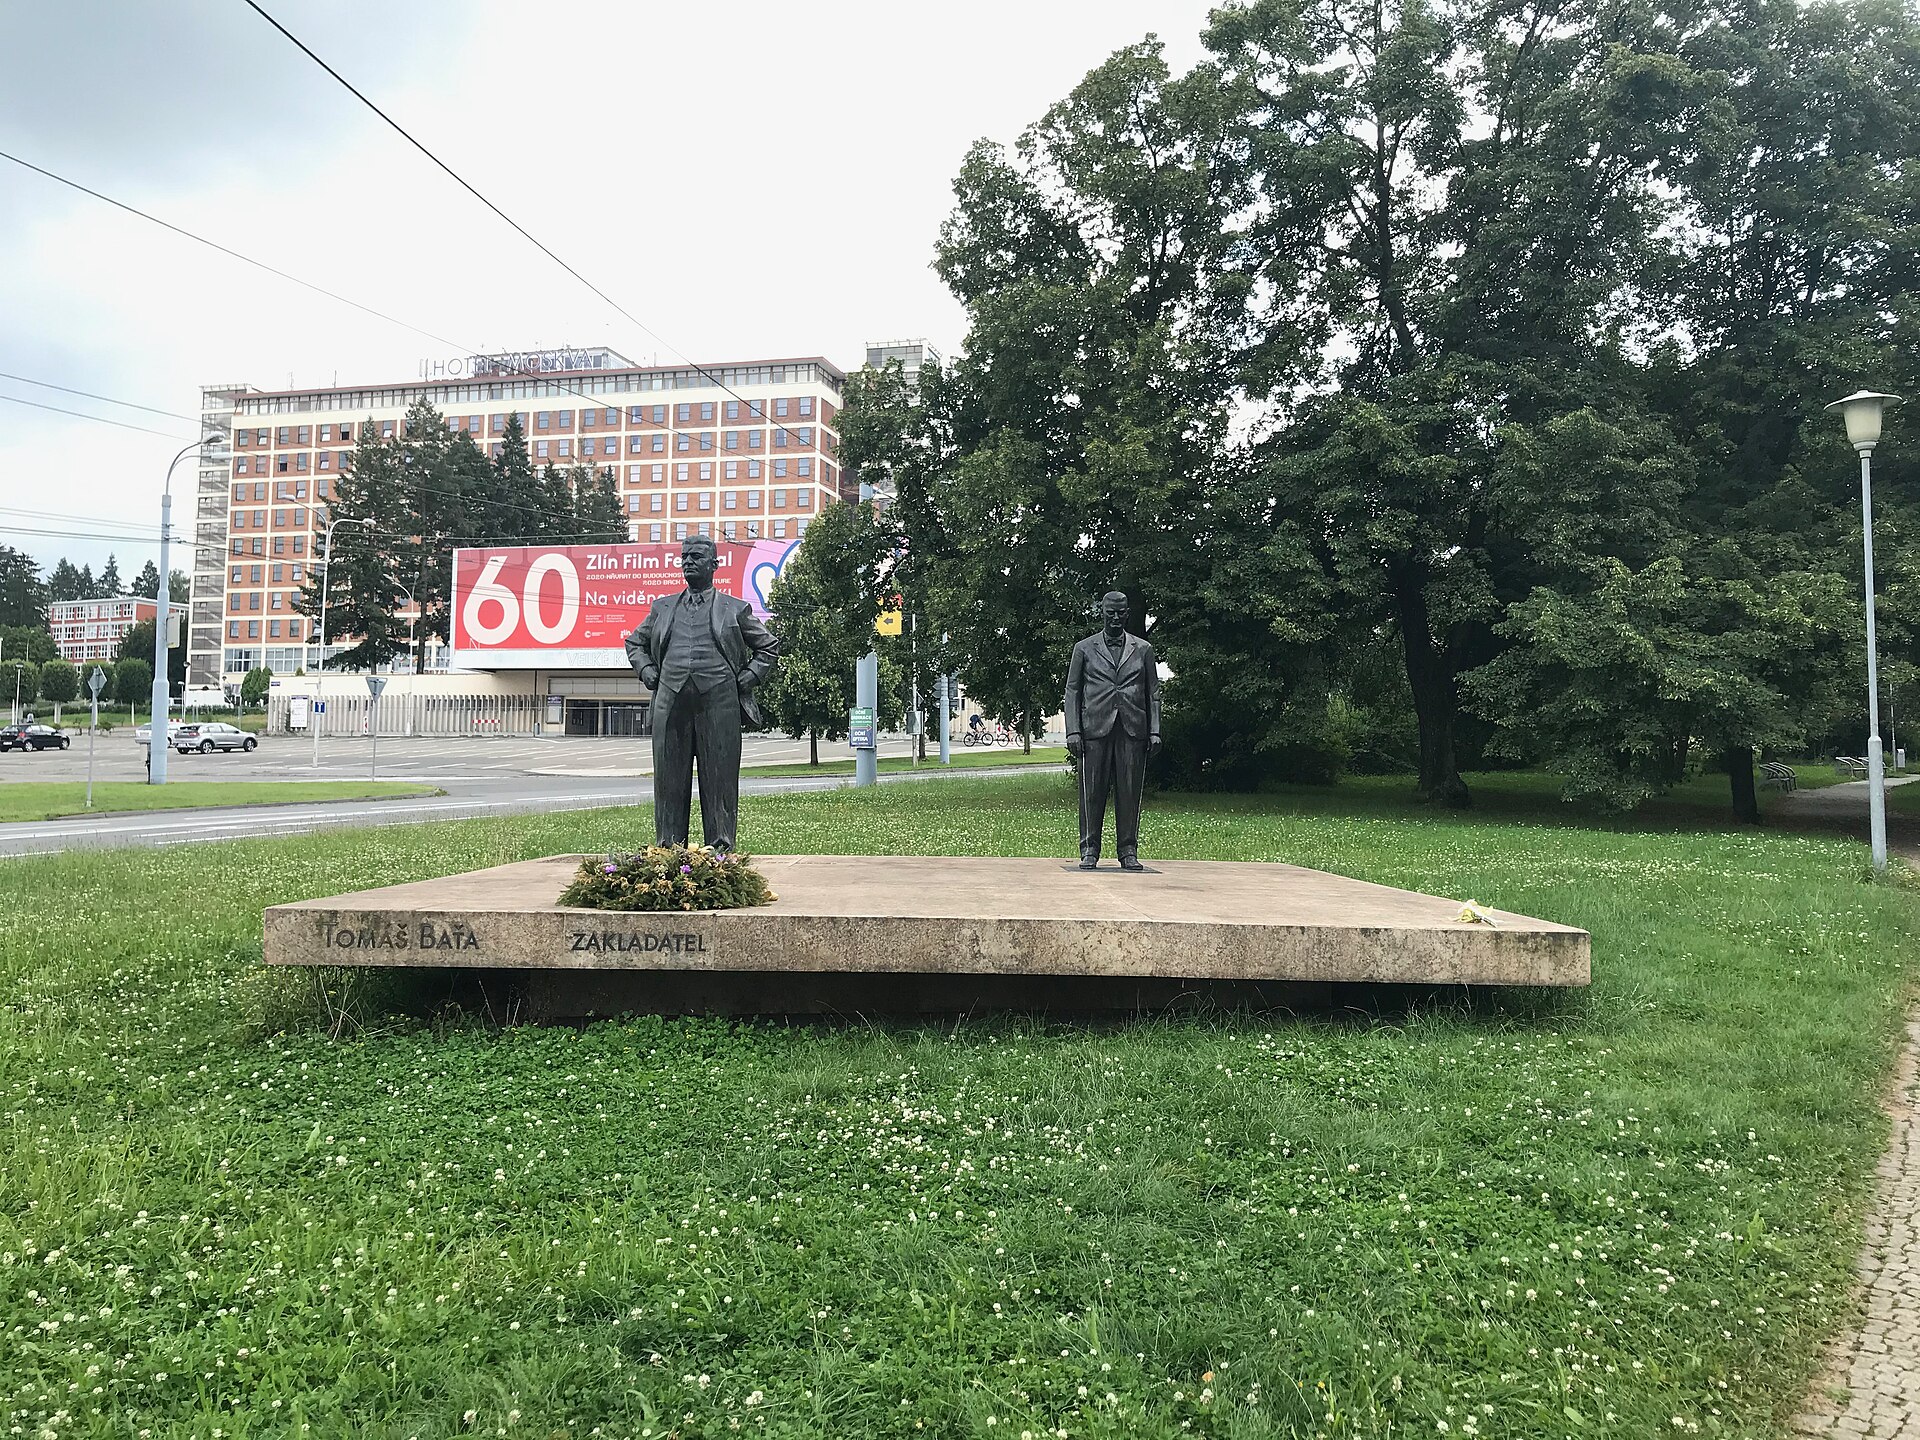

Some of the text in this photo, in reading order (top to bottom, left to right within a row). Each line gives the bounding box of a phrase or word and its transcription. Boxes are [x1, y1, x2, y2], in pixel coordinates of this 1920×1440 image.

[509, 348, 594, 372] MOSKVA
[585, 551, 732, 570] Zlín Film Feal
[463, 553, 580, 646] 60
[585, 591, 608, 606] Na
[567, 649, 610, 667] VELKÉ
[571, 932, 706, 952] ZAKLADATEL
